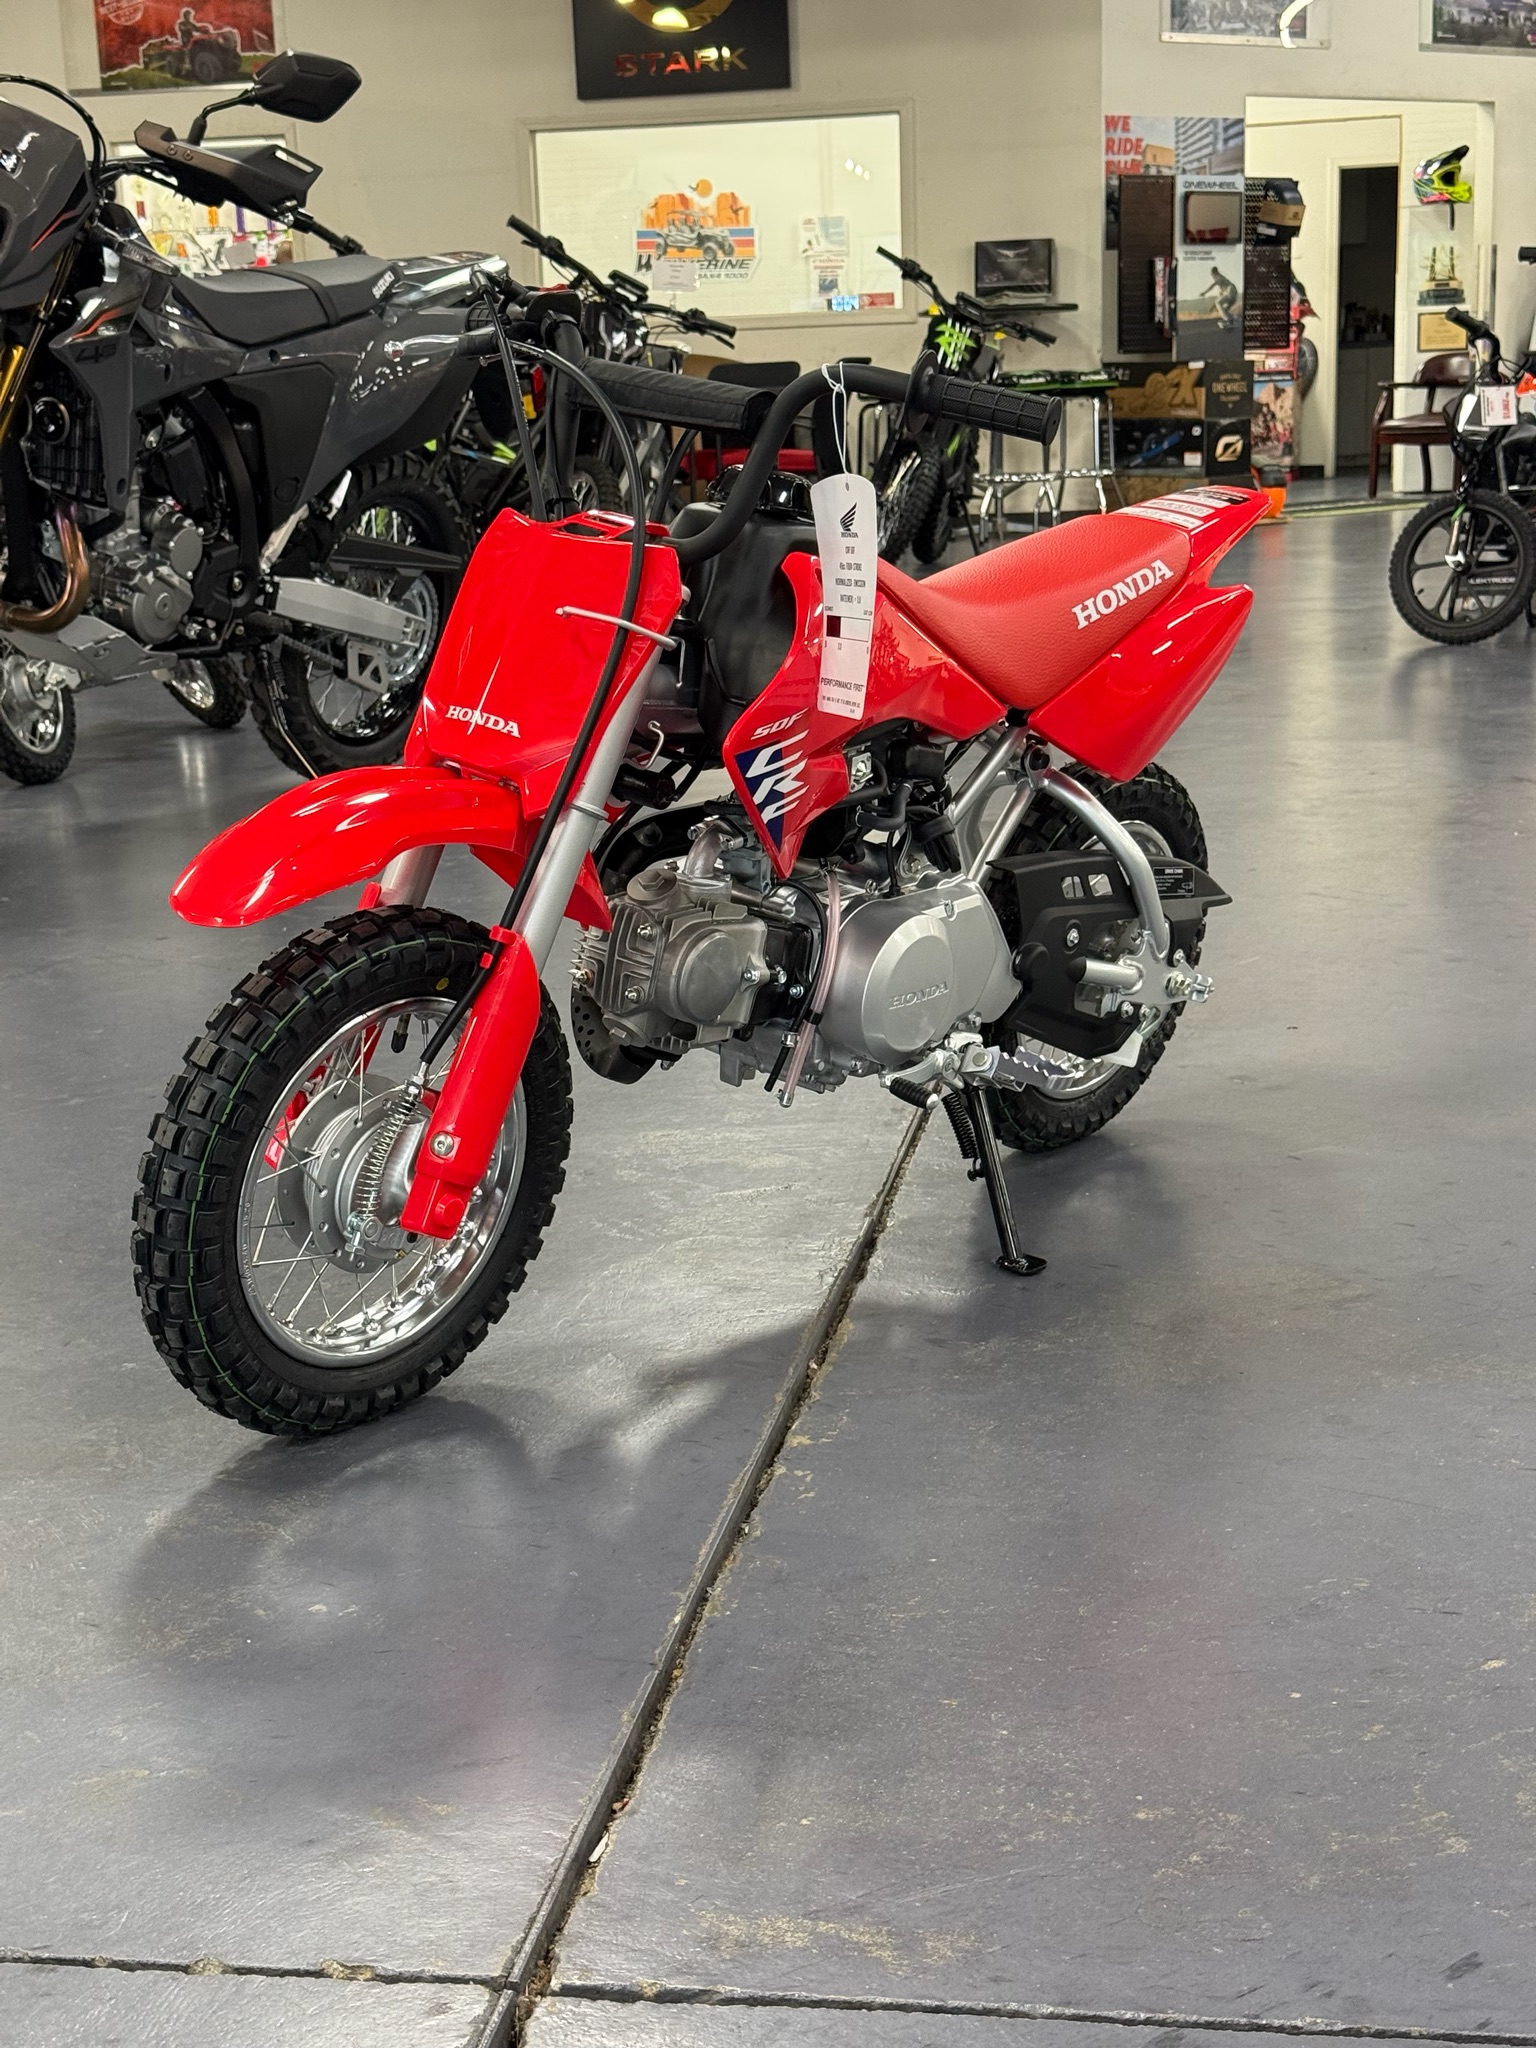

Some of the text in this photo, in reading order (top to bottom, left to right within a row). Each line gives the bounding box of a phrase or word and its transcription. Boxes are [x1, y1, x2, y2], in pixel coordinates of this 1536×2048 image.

[614, 46, 748, 78] STARK
[1105, 115, 1131, 133] WE
[1105, 137, 1144, 155] RIDE
[371, 269, 395, 299] SUZUKI
[841, 531, 859, 539] HONDA
[1071, 559, 1174, 630] HONDA
[821, 677, 866, 693] PERFORMANCE FIRST
[445, 705, 521, 738] HONDA
[751, 707, 809, 740] 50F
[745, 729, 810, 825] CRF
[888, 981, 949, 1010] HONDA
